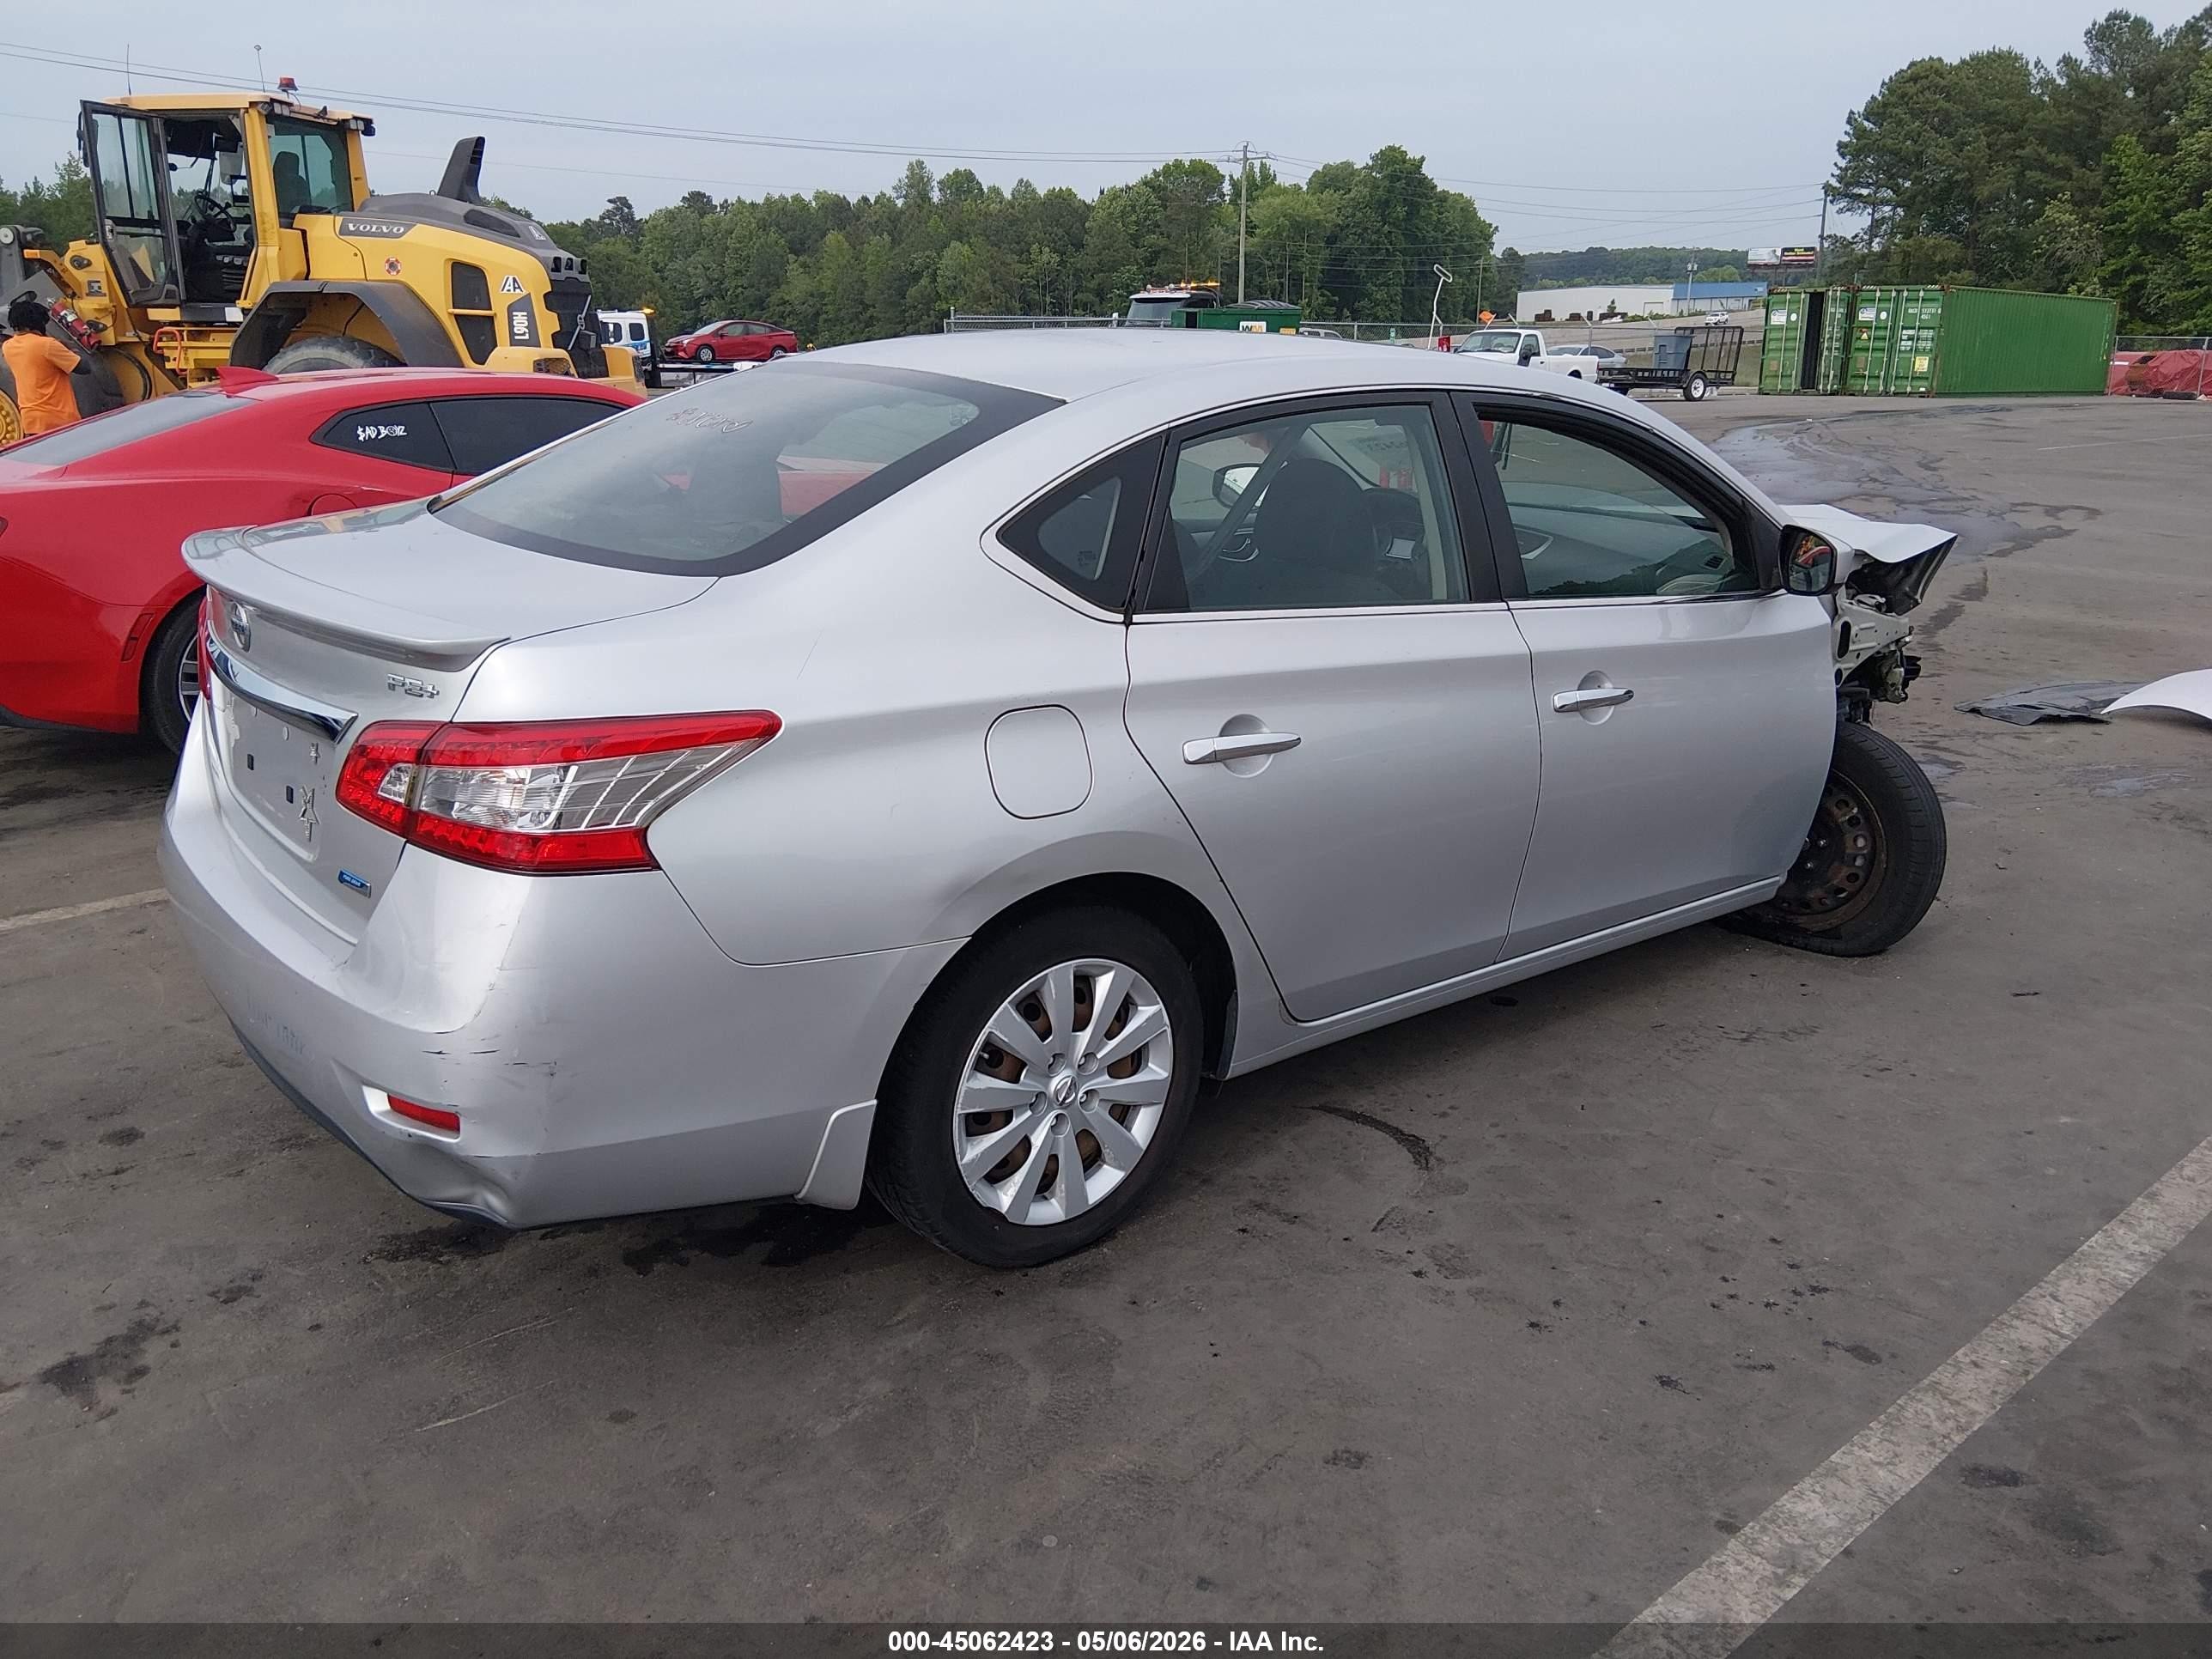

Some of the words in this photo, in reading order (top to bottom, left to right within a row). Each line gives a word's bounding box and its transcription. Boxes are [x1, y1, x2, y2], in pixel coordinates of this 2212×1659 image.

[348, 223, 404, 234] VOLVO
[513, 312, 530, 340] L90H
[386, 672, 441, 699] FE+
